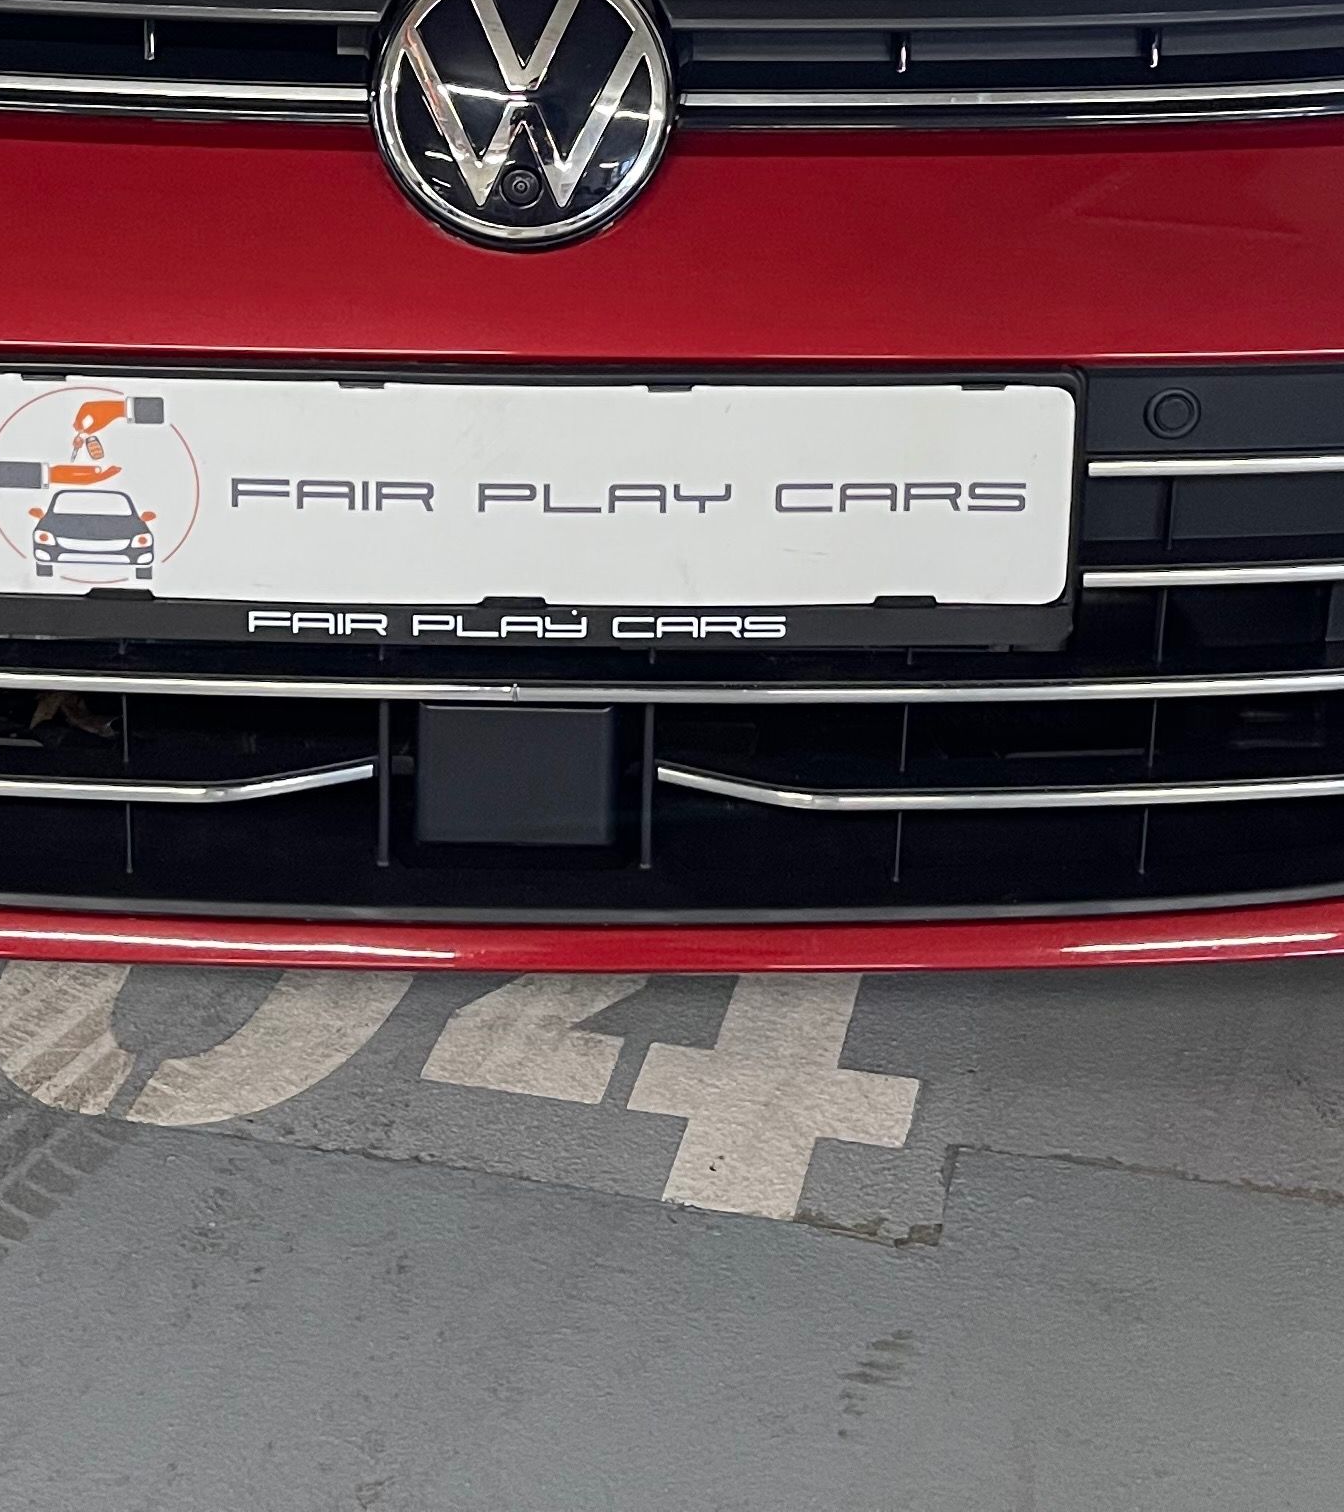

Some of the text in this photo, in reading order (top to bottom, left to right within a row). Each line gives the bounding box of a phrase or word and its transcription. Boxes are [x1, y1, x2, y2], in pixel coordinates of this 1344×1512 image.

[231, 477, 1027, 514] FAIR PLAY CARS
[248, 610, 787, 639] FAIR PLAY CARS
